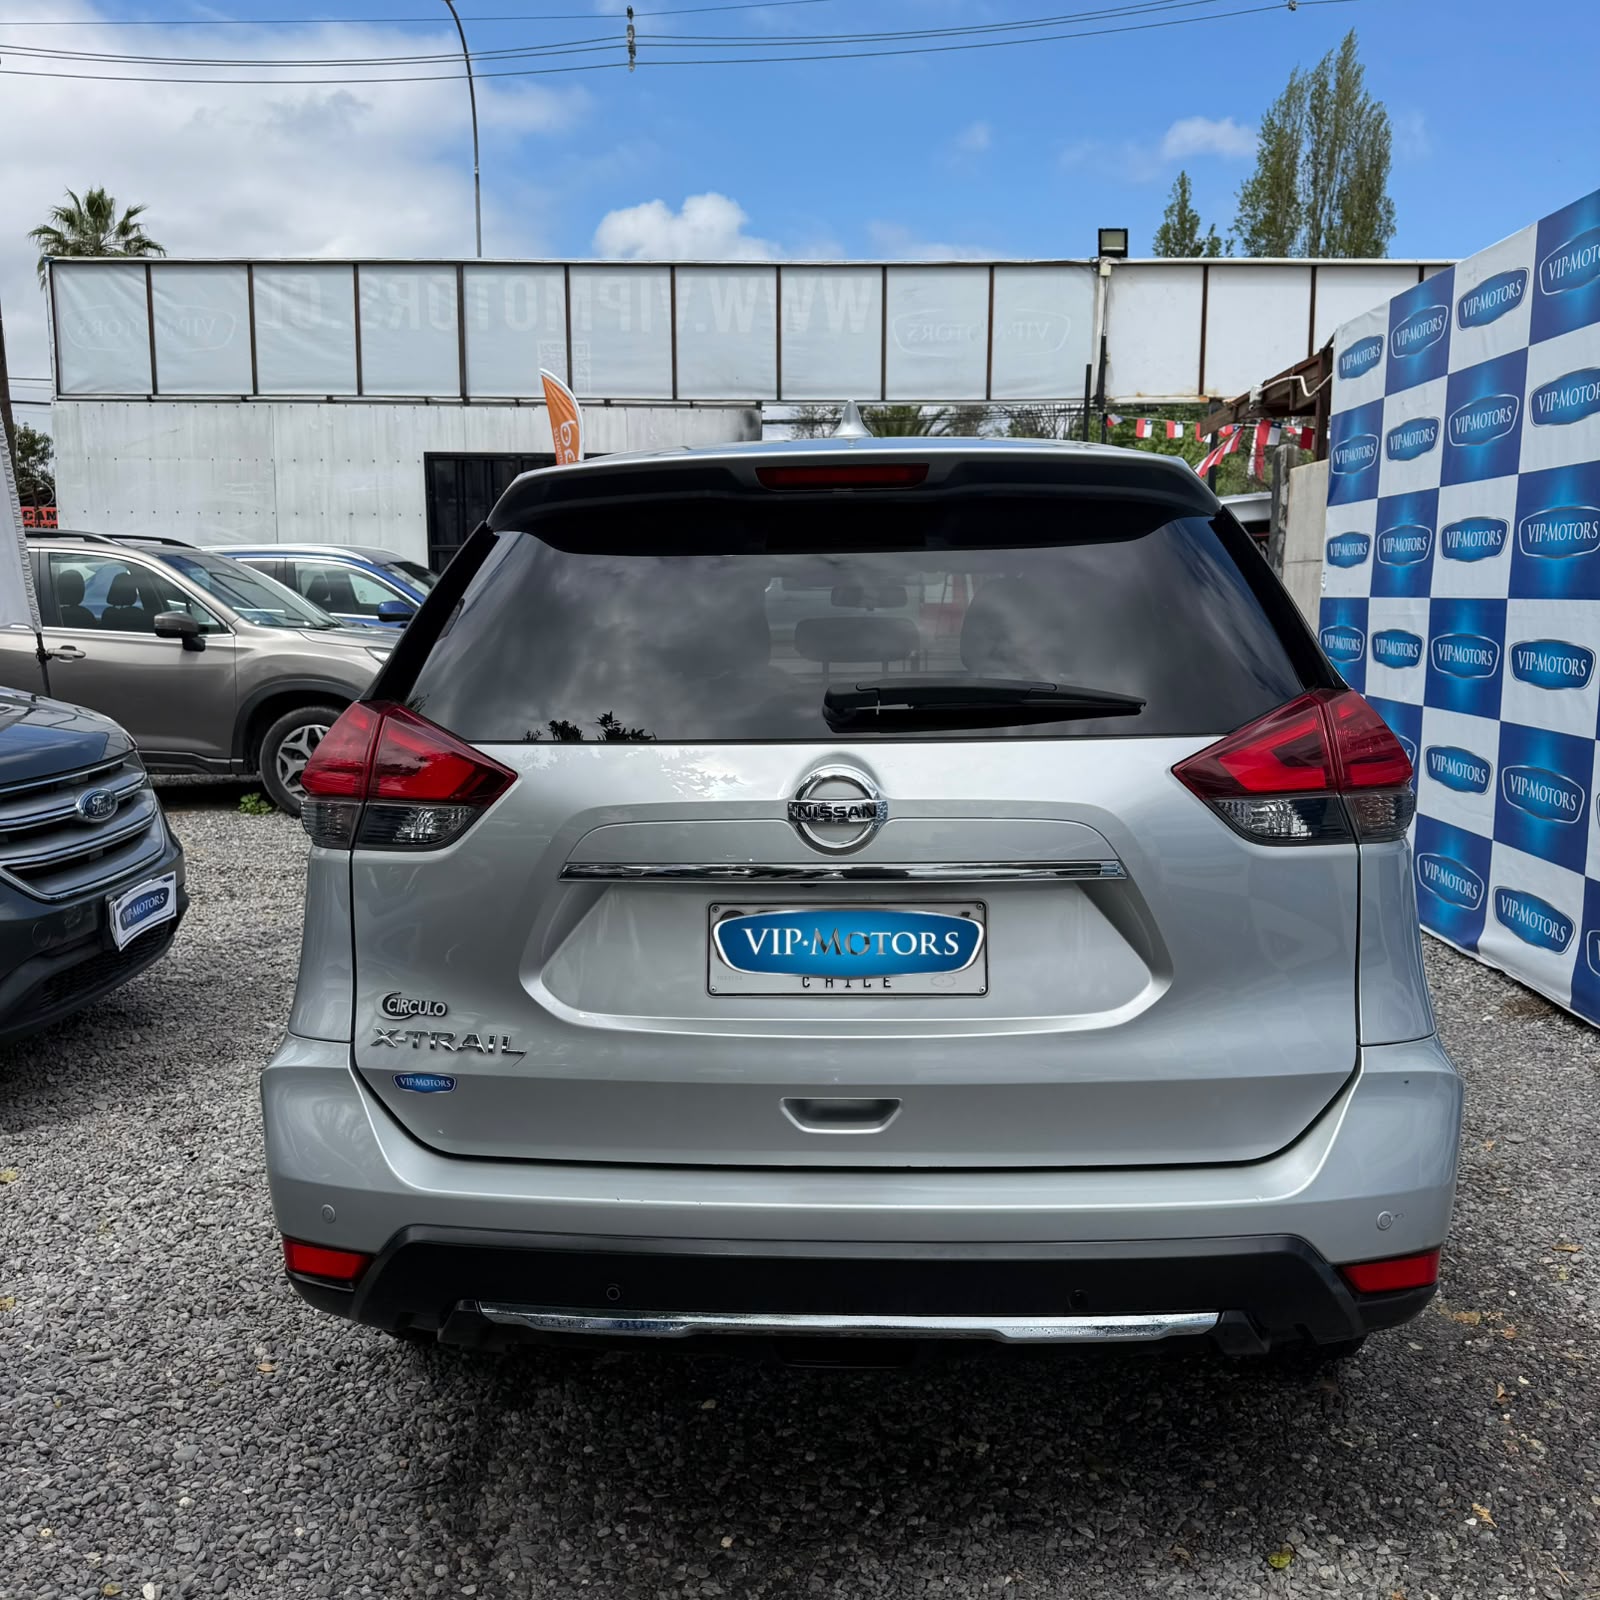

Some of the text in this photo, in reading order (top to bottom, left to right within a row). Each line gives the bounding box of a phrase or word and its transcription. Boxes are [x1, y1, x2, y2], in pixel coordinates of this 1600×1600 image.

[797, 805, 877, 819] NISSAN
[802, 976, 893, 989] CHILE
[371, 1027, 528, 1056] X-TRAIL
